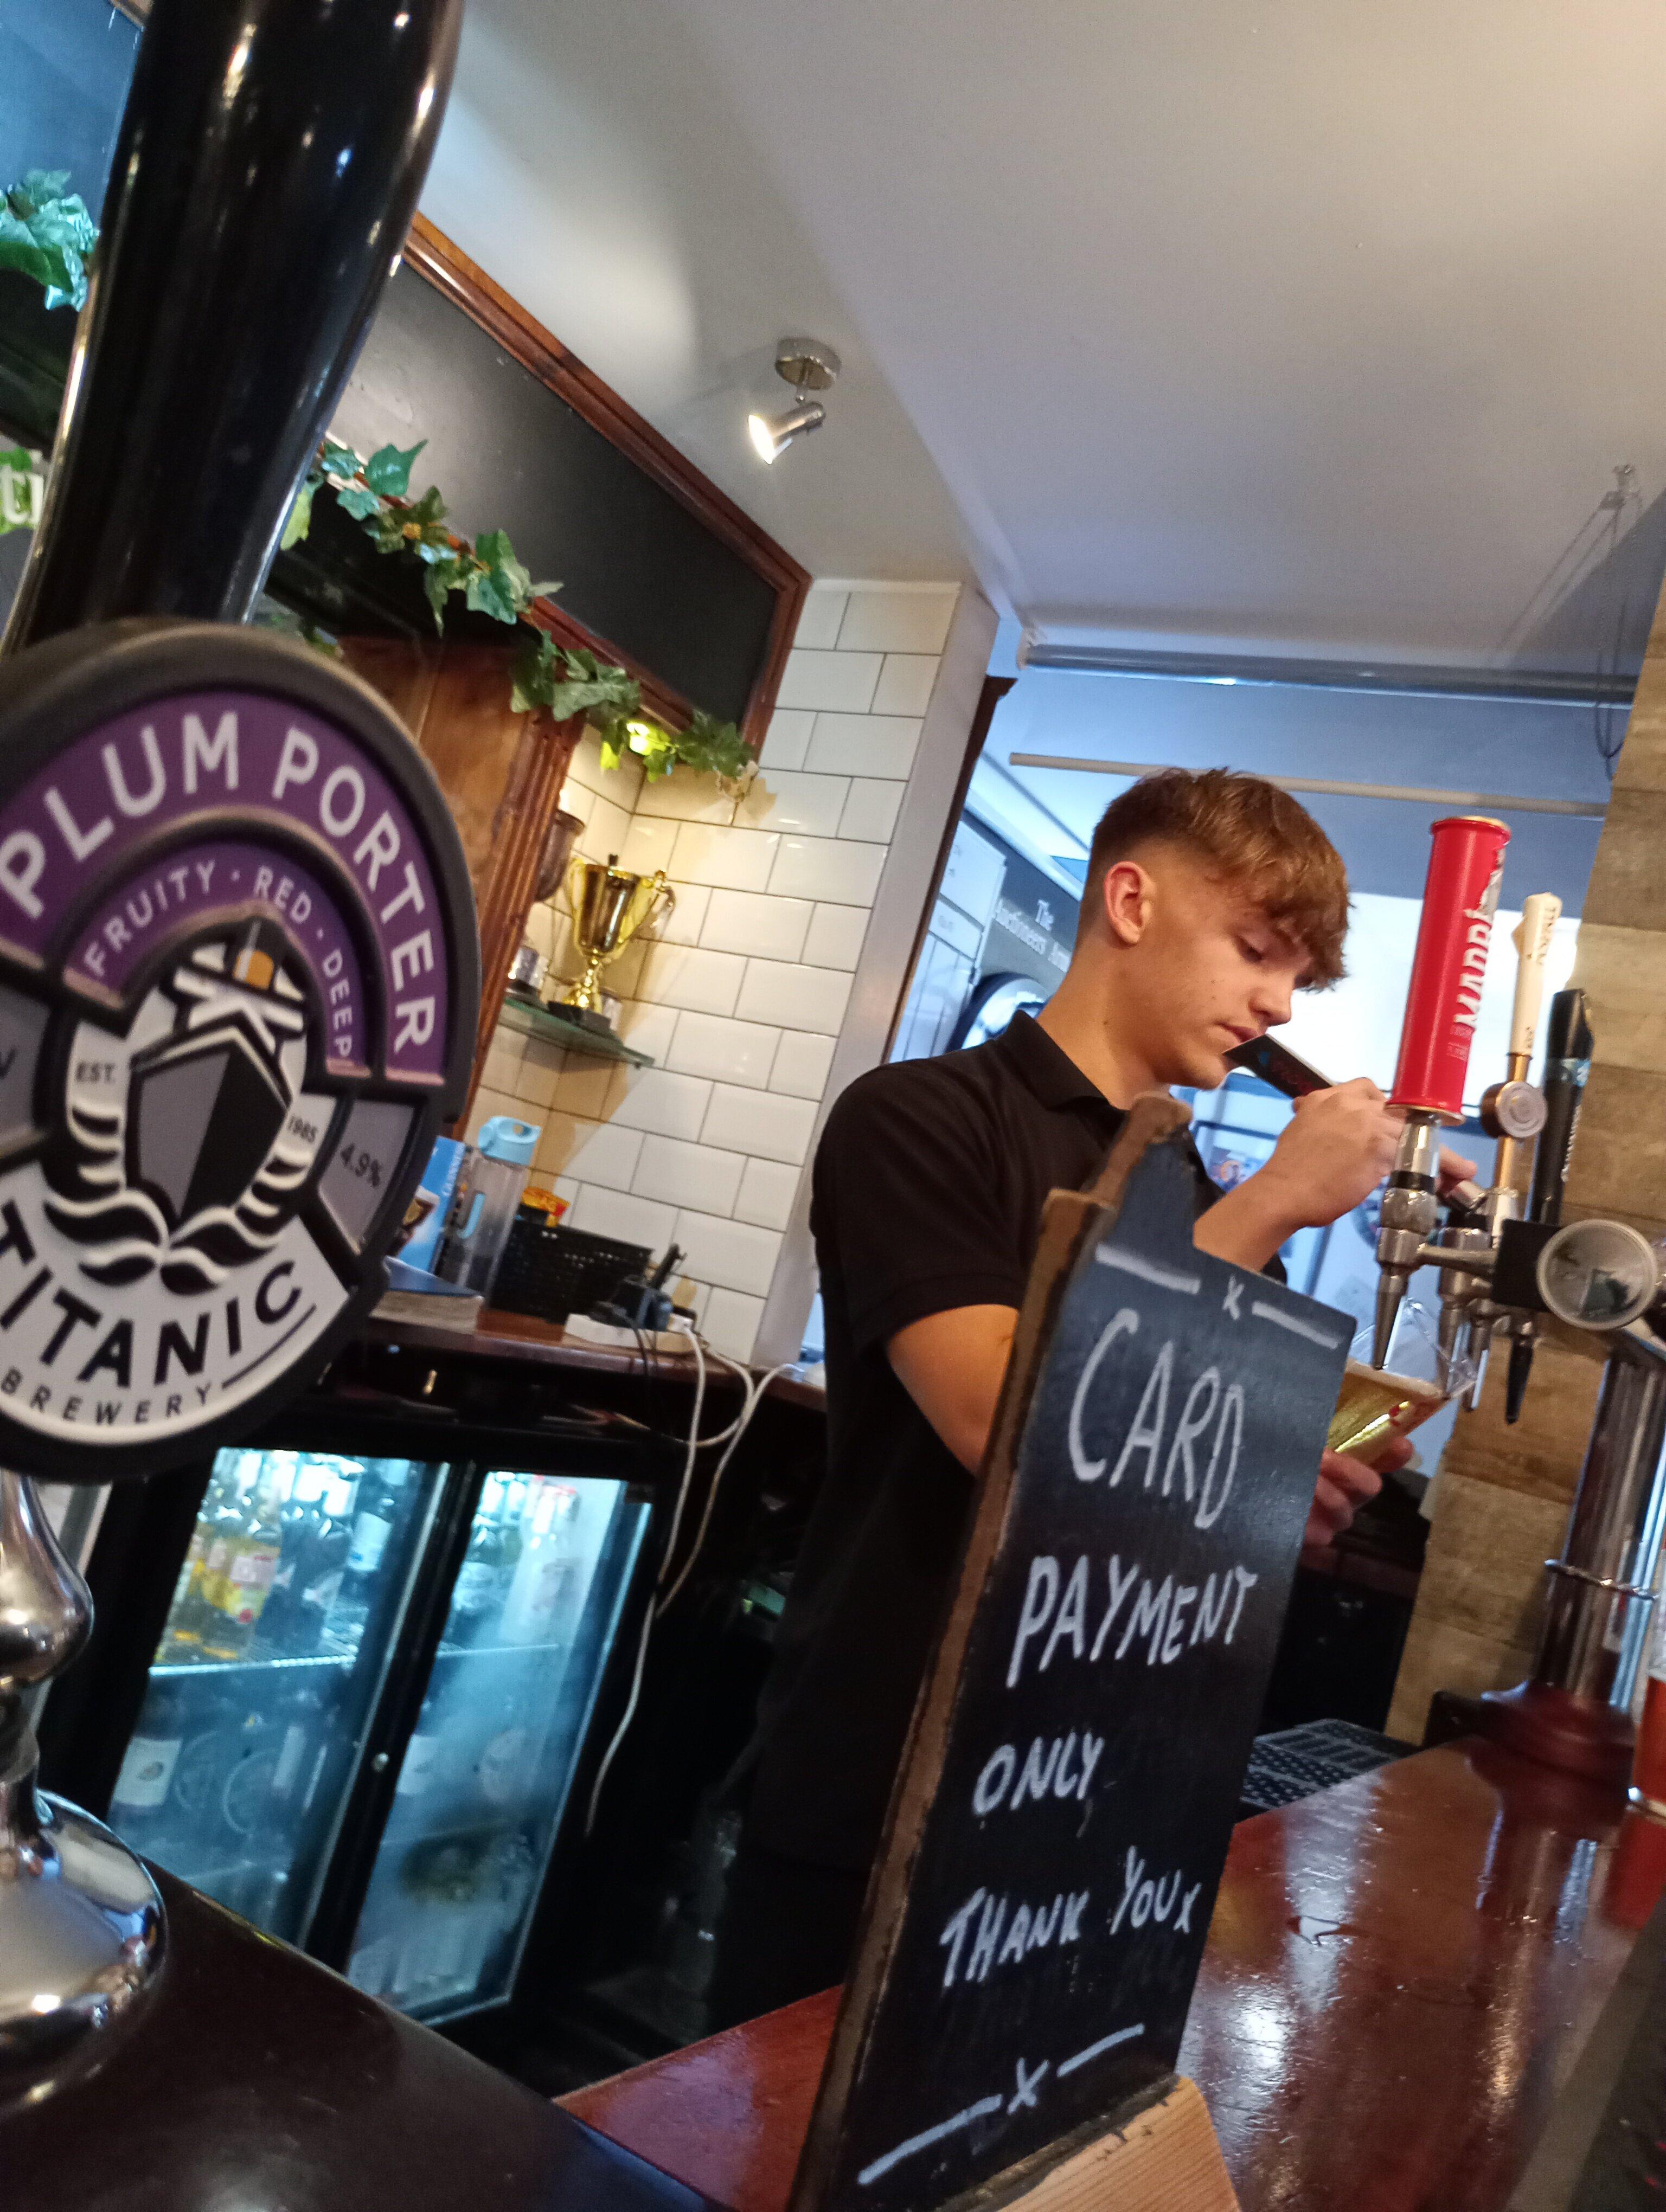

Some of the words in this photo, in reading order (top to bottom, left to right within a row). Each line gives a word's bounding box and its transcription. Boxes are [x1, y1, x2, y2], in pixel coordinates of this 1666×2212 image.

[0, 711, 239, 919] PLUM
[272, 726, 435, 1053] PORTER
[84, 860, 215, 977] FRUITY
[254, 866, 312, 924] RED
[323, 948, 353, 1056] DEEP
[340, 1142, 382, 1188] 4.9%
[0, 1201, 302, 1388] TITANIC
[1, 1369, 212, 1425] BREWERY
[1069, 1308, 1244, 1529] CARD
[1006, 1554, 1258, 1689] PAYMENT
[974, 1727, 1104, 1815] ONLY
[940, 1886, 1089, 1988] THANK
